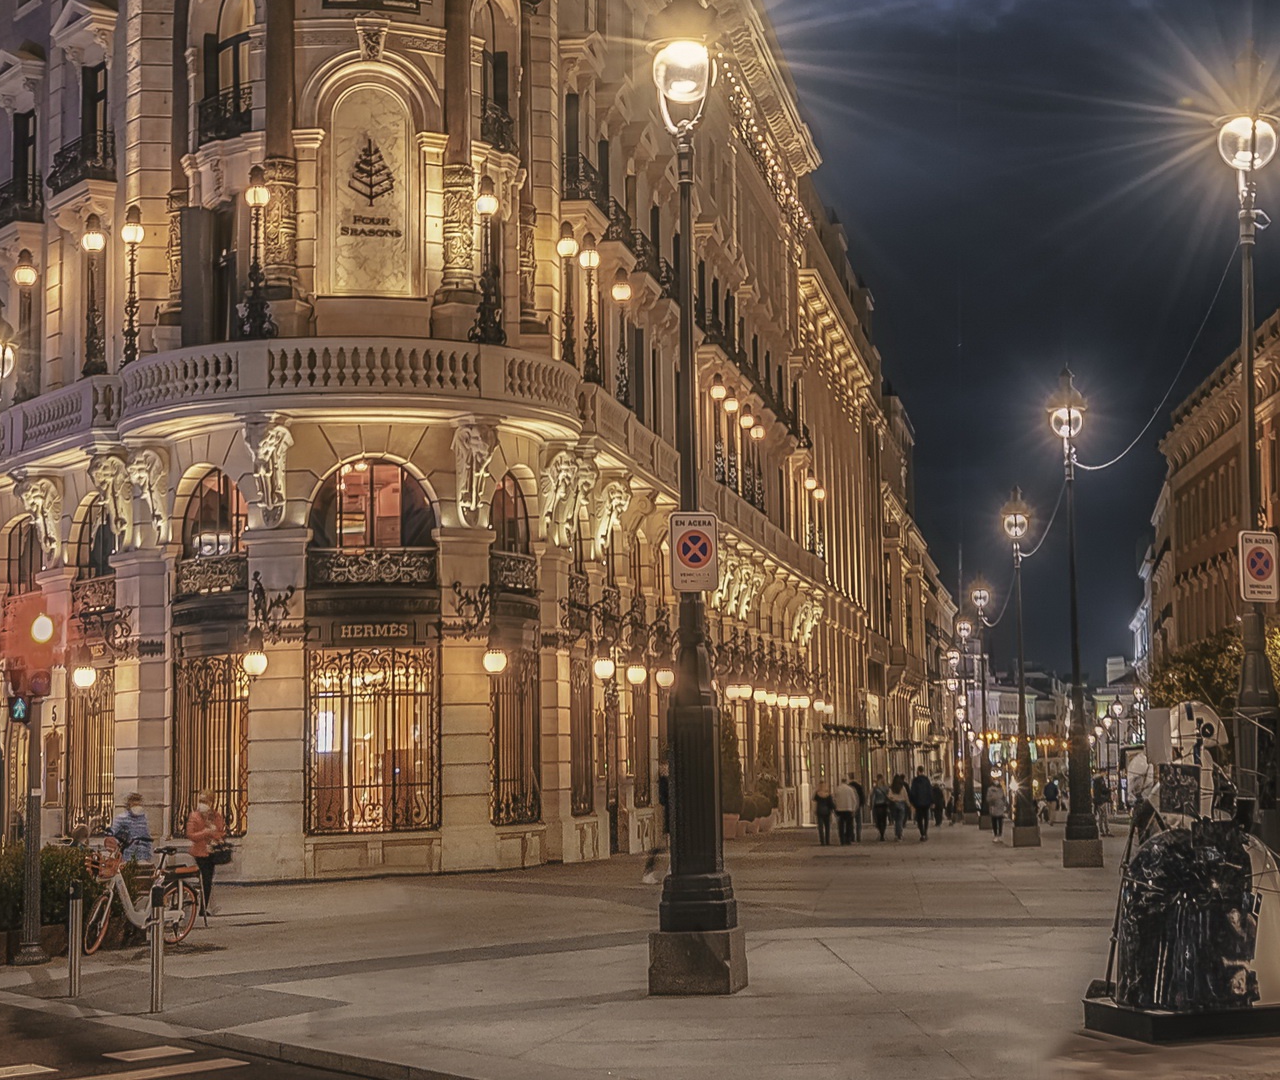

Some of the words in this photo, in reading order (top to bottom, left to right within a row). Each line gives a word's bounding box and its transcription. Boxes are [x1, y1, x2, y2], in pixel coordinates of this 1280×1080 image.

[352, 214, 391, 226] FOUR
[340, 226, 403, 238] SEASONS
[52, 705, 57, 722] 5
